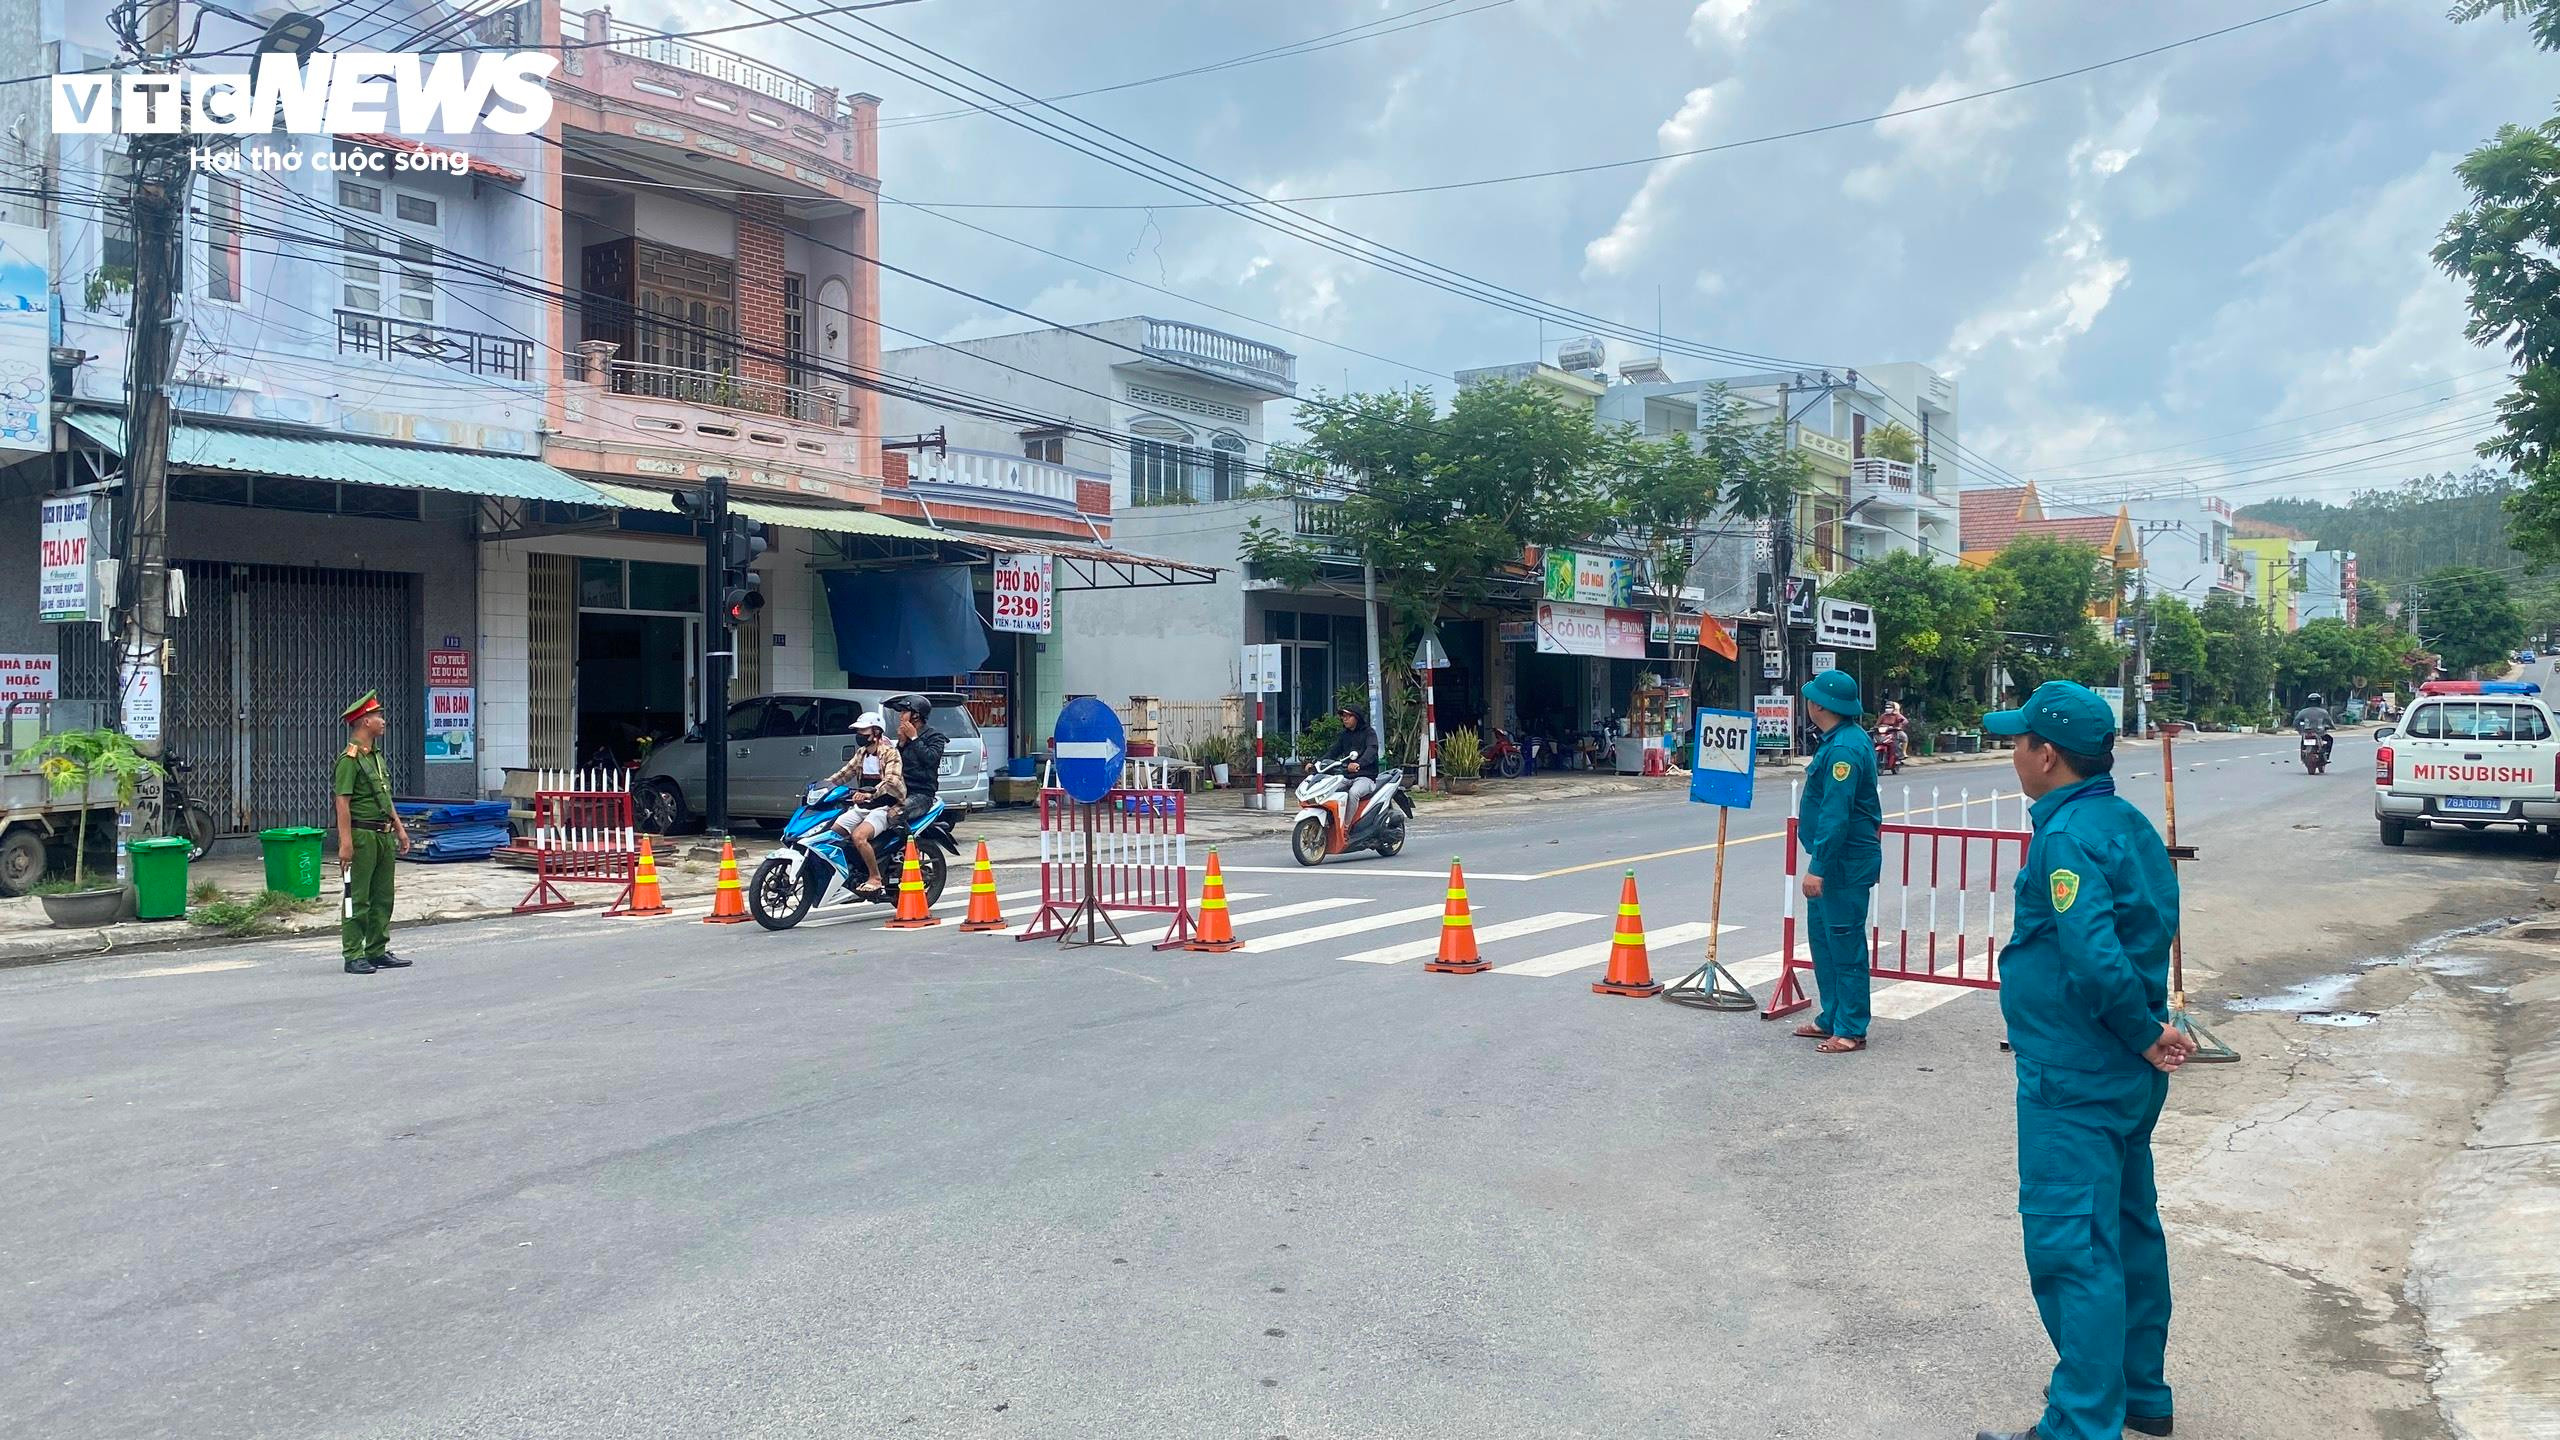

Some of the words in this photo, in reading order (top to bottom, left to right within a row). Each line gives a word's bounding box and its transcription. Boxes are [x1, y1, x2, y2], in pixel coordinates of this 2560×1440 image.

[43, 529, 70, 568] THẢO
[72, 538, 87, 565] MY
[996, 561, 1021, 591] PHỞ
[1023, 565, 1040, 592] BÒ
[1592, 573, 1604, 588] NGA
[997, 595, 1039, 617] 239
[1557, 618, 1575, 637] CÔ
[1577, 623, 1602, 639] NGA
[1621, 621, 1645, 633] BIVINA
[25, 658, 52, 670] BÁN
[433, 655, 447, 665] CHO
[448, 654, 466, 665] THUÊ
[6, 674, 40, 687] HOẶC
[432, 667, 441, 677] XE
[442, 667, 452, 677] DU
[453, 667, 468, 679] LỊCH
[434, 691, 451, 714] NHÀ
[453, 691, 469, 714] BÁN
[1703, 725, 1747, 750] CSGT
[2414, 764, 2533, 783] MITSUBISHI
